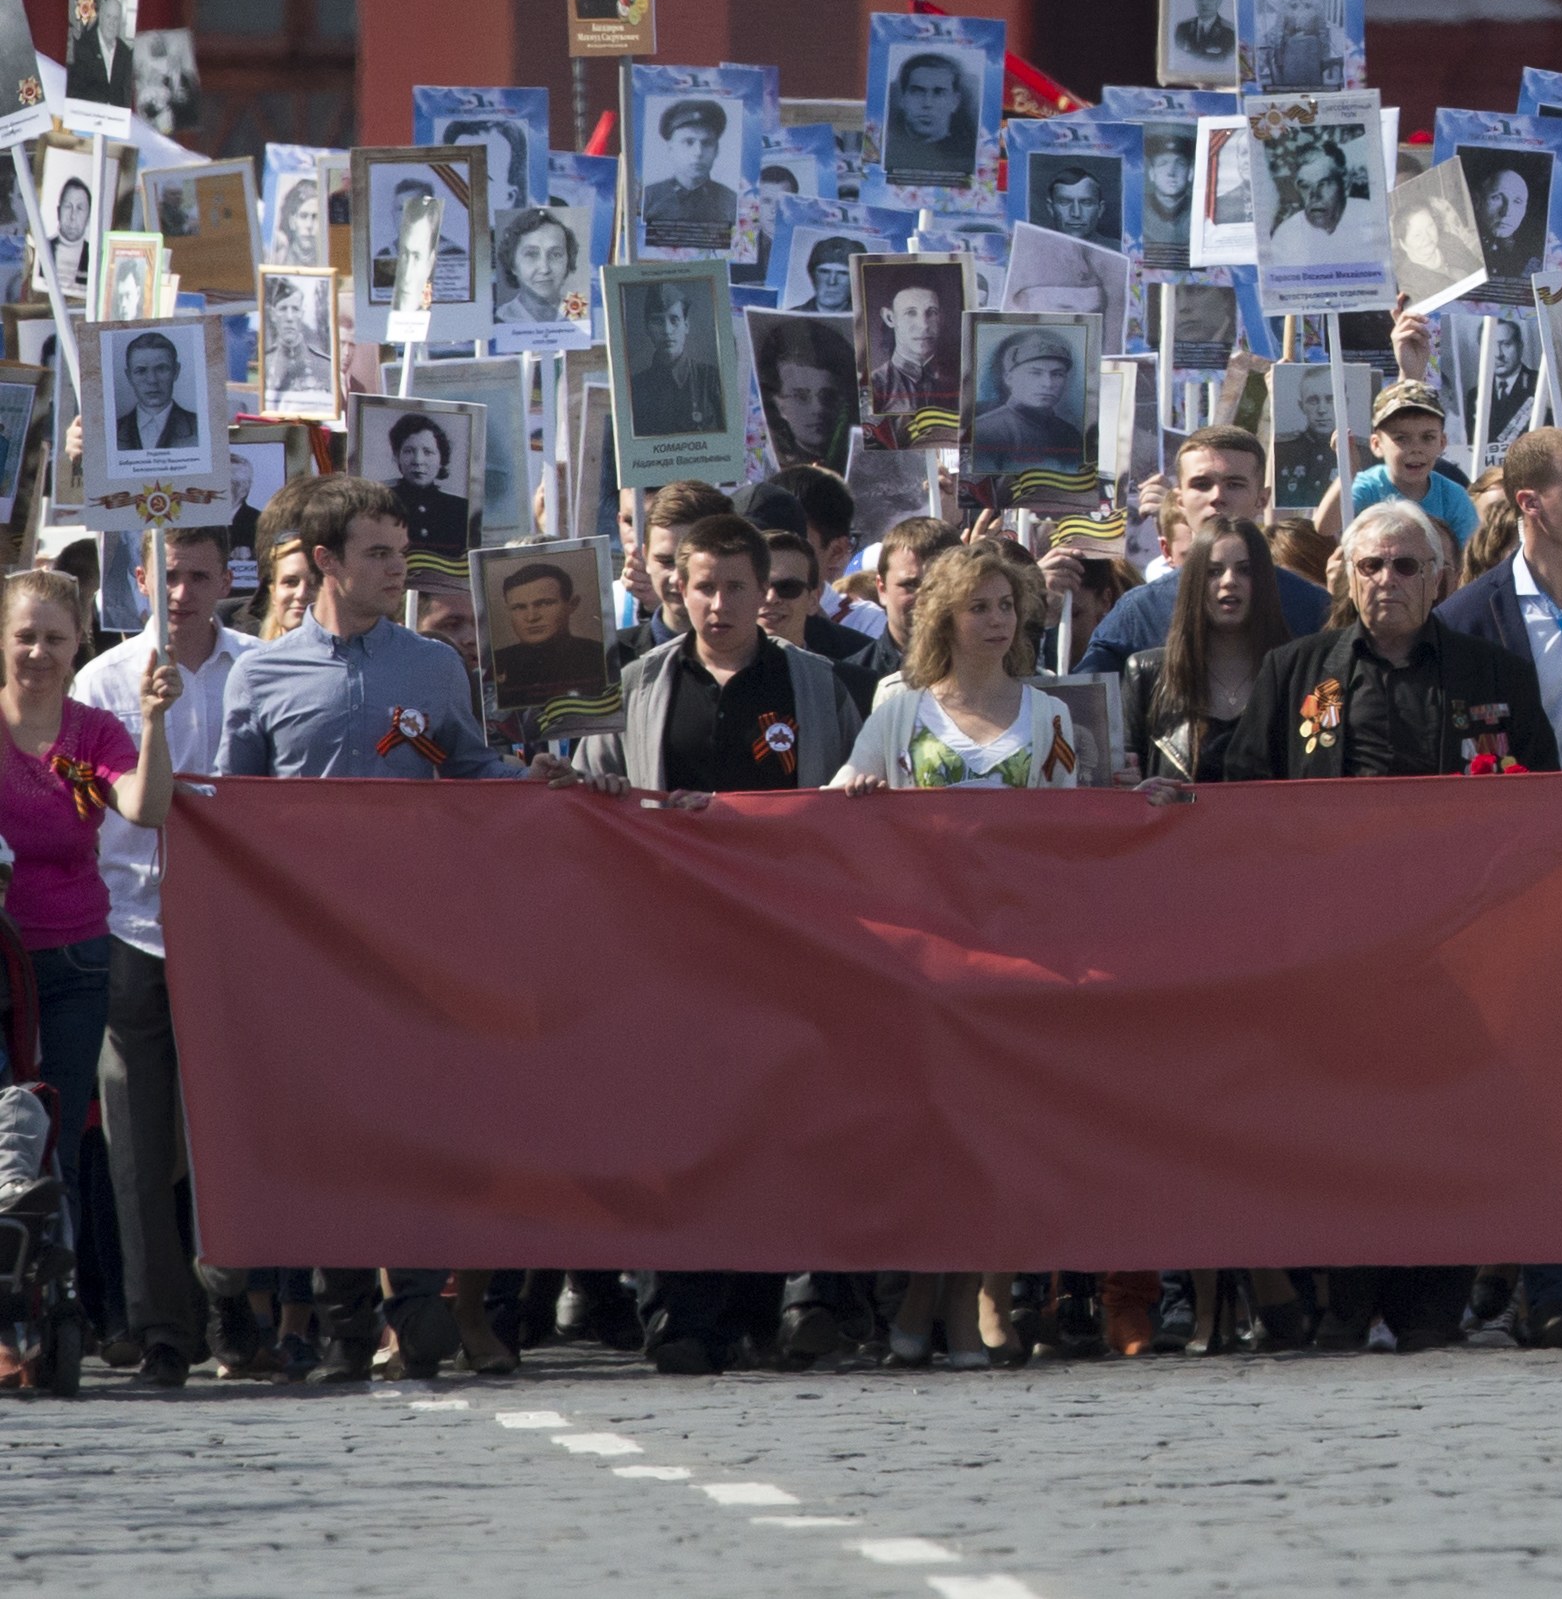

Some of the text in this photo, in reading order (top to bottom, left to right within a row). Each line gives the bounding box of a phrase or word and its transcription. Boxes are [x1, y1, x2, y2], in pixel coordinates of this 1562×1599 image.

[1302, 272, 1334, 281] Василий
[1335, 269, 1382, 280] Михайлович
[653, 440, 708, 454] КОМАРОВА
[632, 454, 732, 470] Надежда Васильевна
